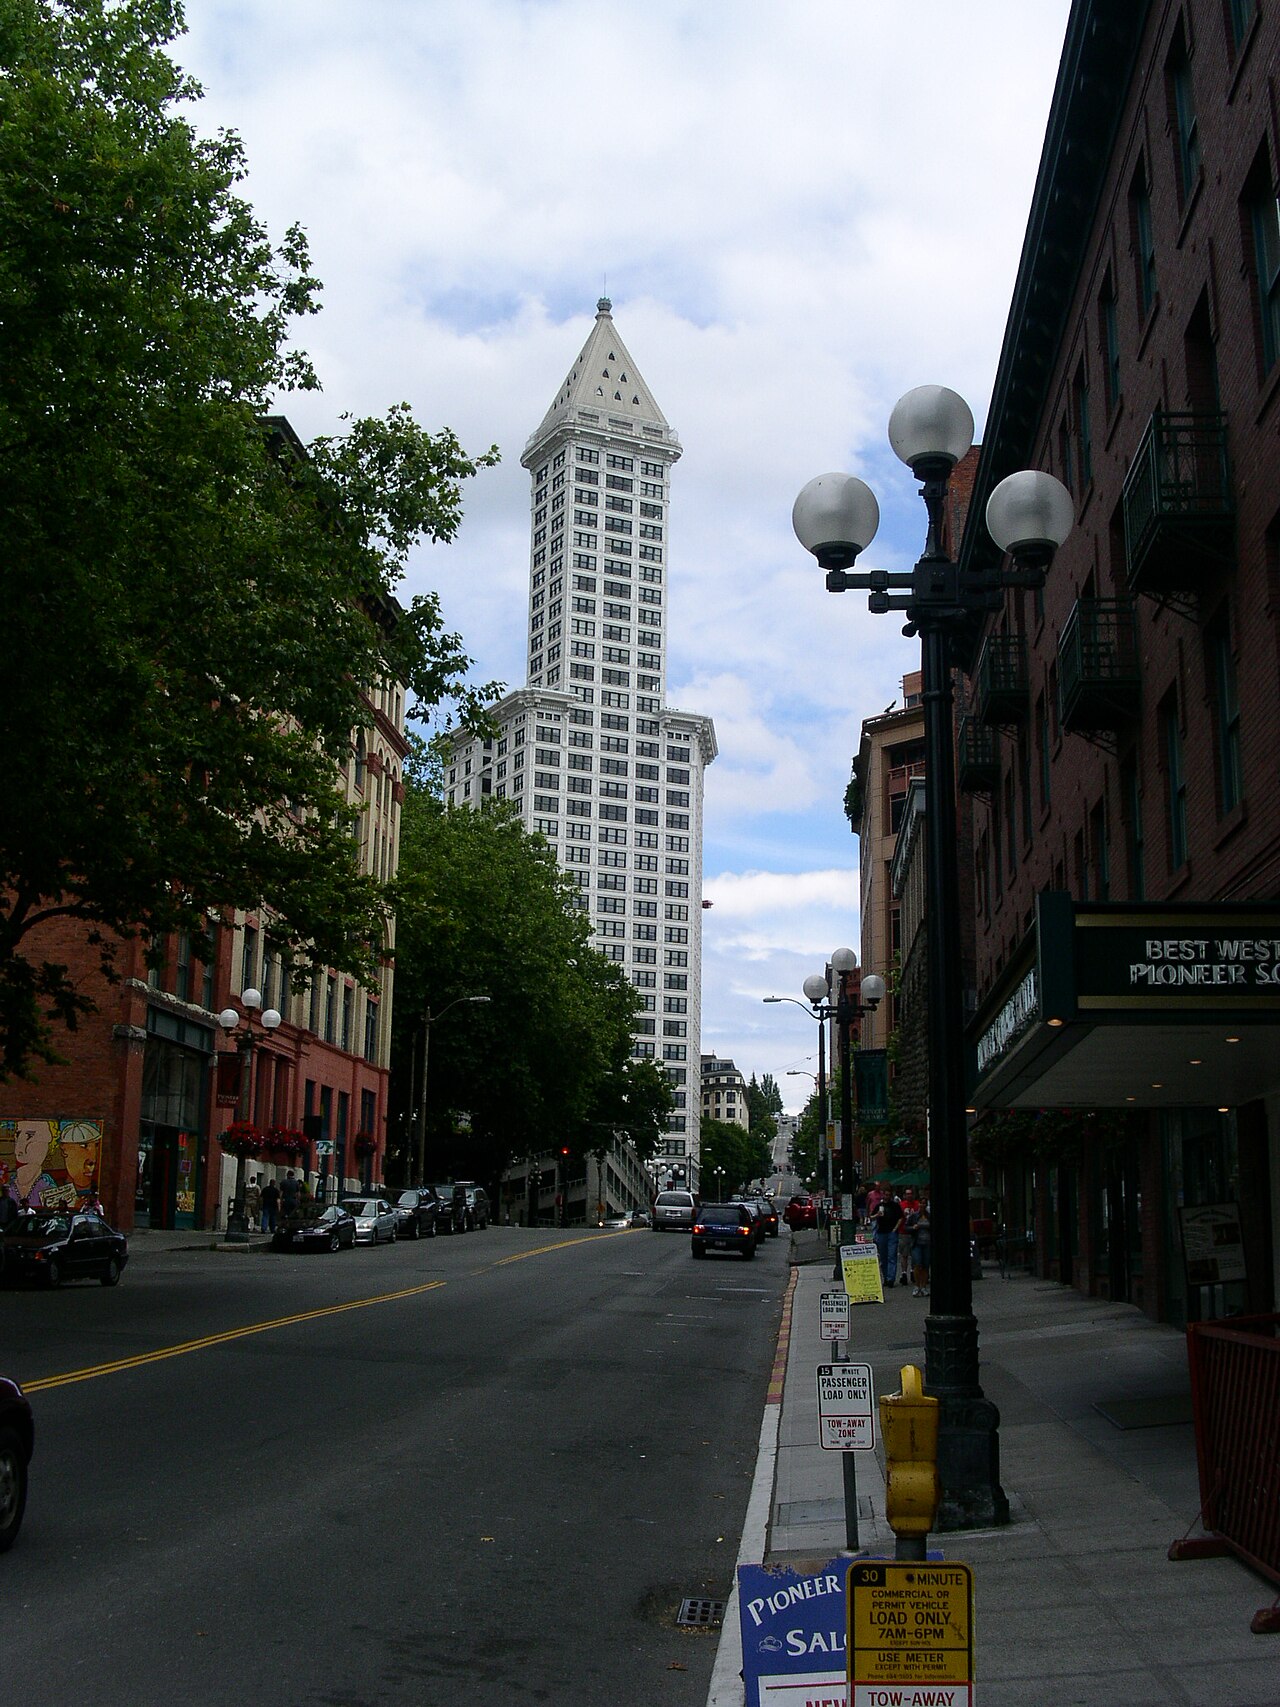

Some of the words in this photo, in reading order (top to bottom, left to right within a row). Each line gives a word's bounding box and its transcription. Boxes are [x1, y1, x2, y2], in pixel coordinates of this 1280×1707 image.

[1145, 940, 1210, 960] BEST
[1129, 963, 1248, 985] PIONEER
[820, 1367, 830, 1375] 15
[821, 1377, 867, 1388] PASSENGER
[823, 1390, 843, 1400] LOAD
[848, 1390, 867, 1400] ONLY
[828, 1419, 865, 1428] TOW-AWAY
[838, 1429, 856, 1438] ZONE
[861, 1570, 879, 1583] 30
[917, 1573, 963, 1586] MINUTE
[871, 1590, 933, 1599] COMMERCIAL
[936, 1590, 950, 1599] OR
[747, 1575, 843, 1627] PIONEER
[872, 1601, 905, 1610] PERMIT
[909, 1601, 949, 1610] VEHICLE
[869, 1611, 908, 1625] LOAD
[914, 1611, 951, 1625] ONLY
[878, 1628, 945, 1639] 7AM-6PM
[786, 1629, 847, 1657] SAL
[878, 1653, 900, 1663] USE
[906, 1653, 944, 1663] METER
[867, 1692, 955, 1707] TOW-AWAY
